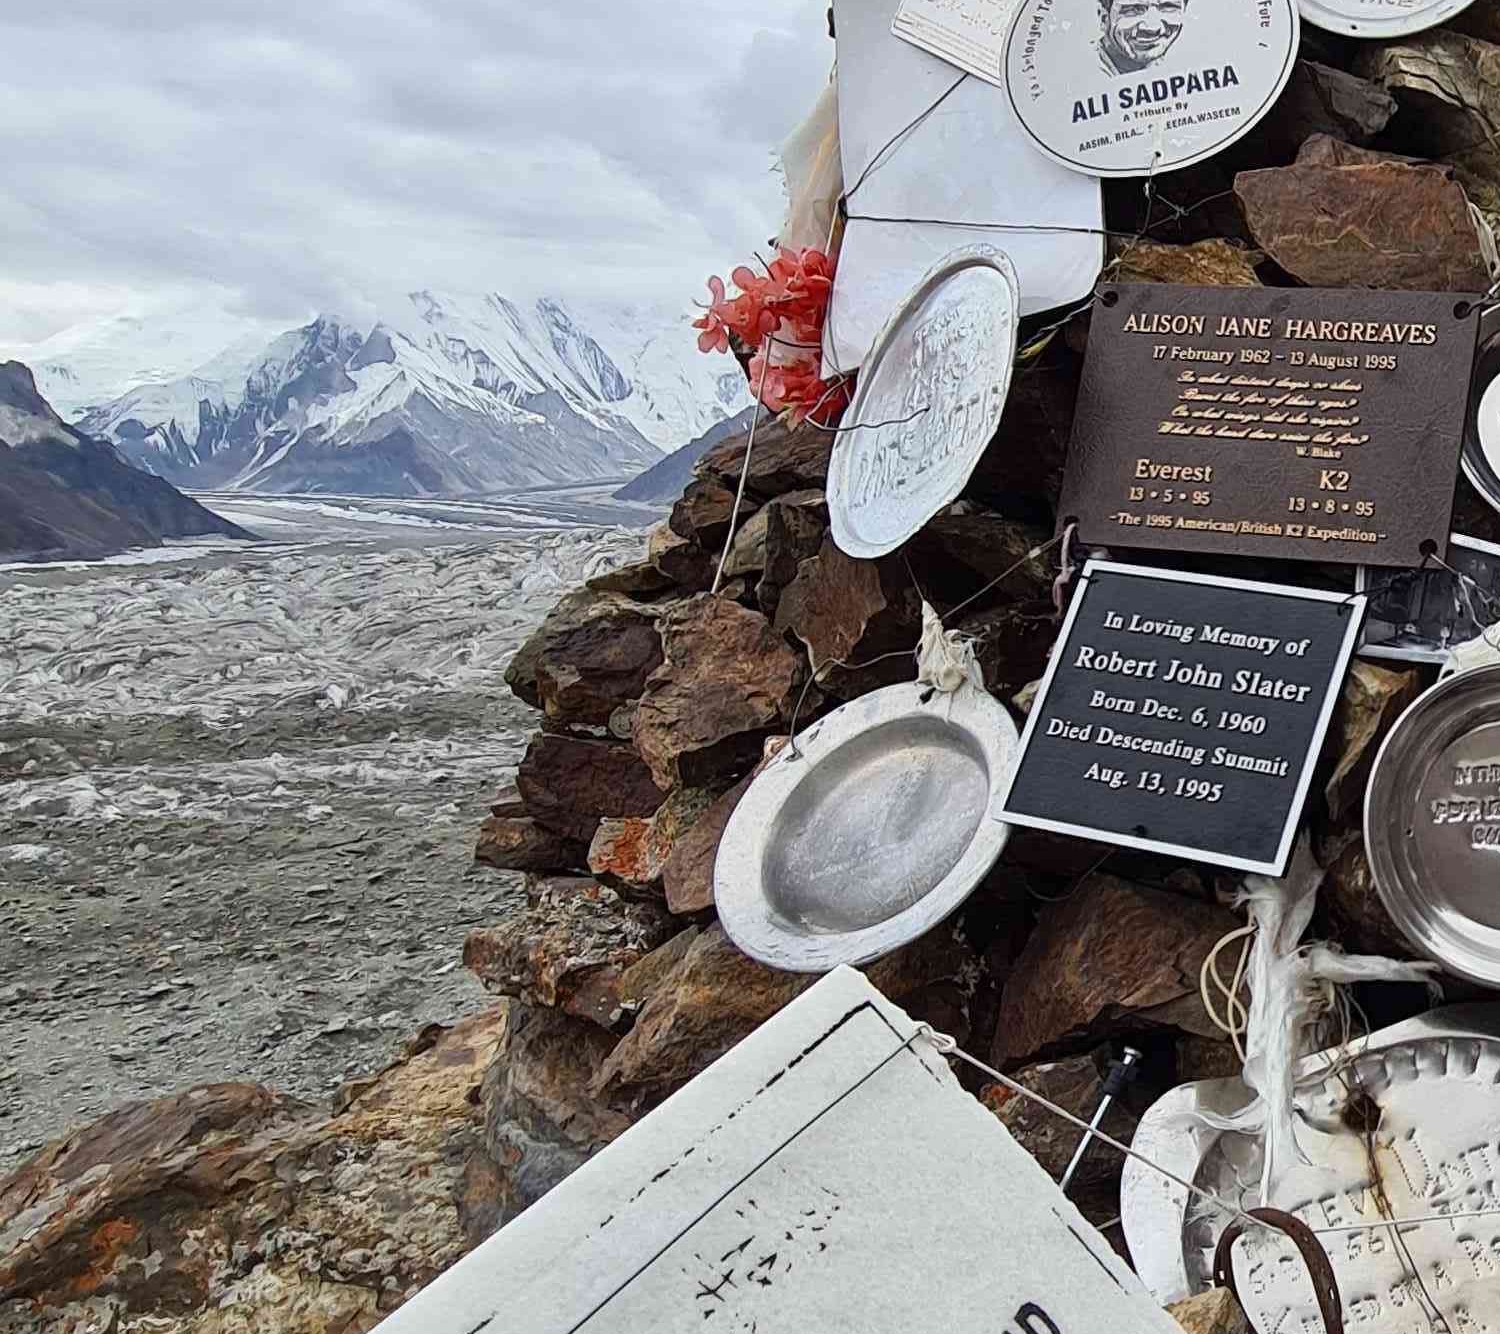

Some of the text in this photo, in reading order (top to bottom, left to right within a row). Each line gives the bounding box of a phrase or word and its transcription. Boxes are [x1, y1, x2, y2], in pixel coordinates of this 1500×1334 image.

[1072, 93, 1110, 123] ALI
[1118, 65, 1240, 111] SADPARA
[1133, 103, 1172, 121] Tribute
[1174, 101, 1189, 113] By
[1123, 313, 1438, 346] ALISON JANE HARGREAVES
[1152, 345, 1397, 371] 17 February 1962 13 August 1995
[1311, 447, 1343, 460] Blake
[1134, 458, 1350, 491] Everest K2
[1128, 486, 1211, 506] 13 5 95
[1288, 497, 1375, 517] 13 8 95
[1146, 514, 1173, 529] 1995
[1174, 516, 1282, 536] American/British
[1285, 523, 1304, 538] K2
[1103, 610, 1311, 657] In Loving Memory of
[1074, 645, 1312, 704] Robert John Slater
[1088, 689, 1267, 735] Born Dec. 6, 1960
[1046, 718, 1289, 778] Died Descending Summit
[1083, 761, 1224, 803] Aug. 13, 1995
